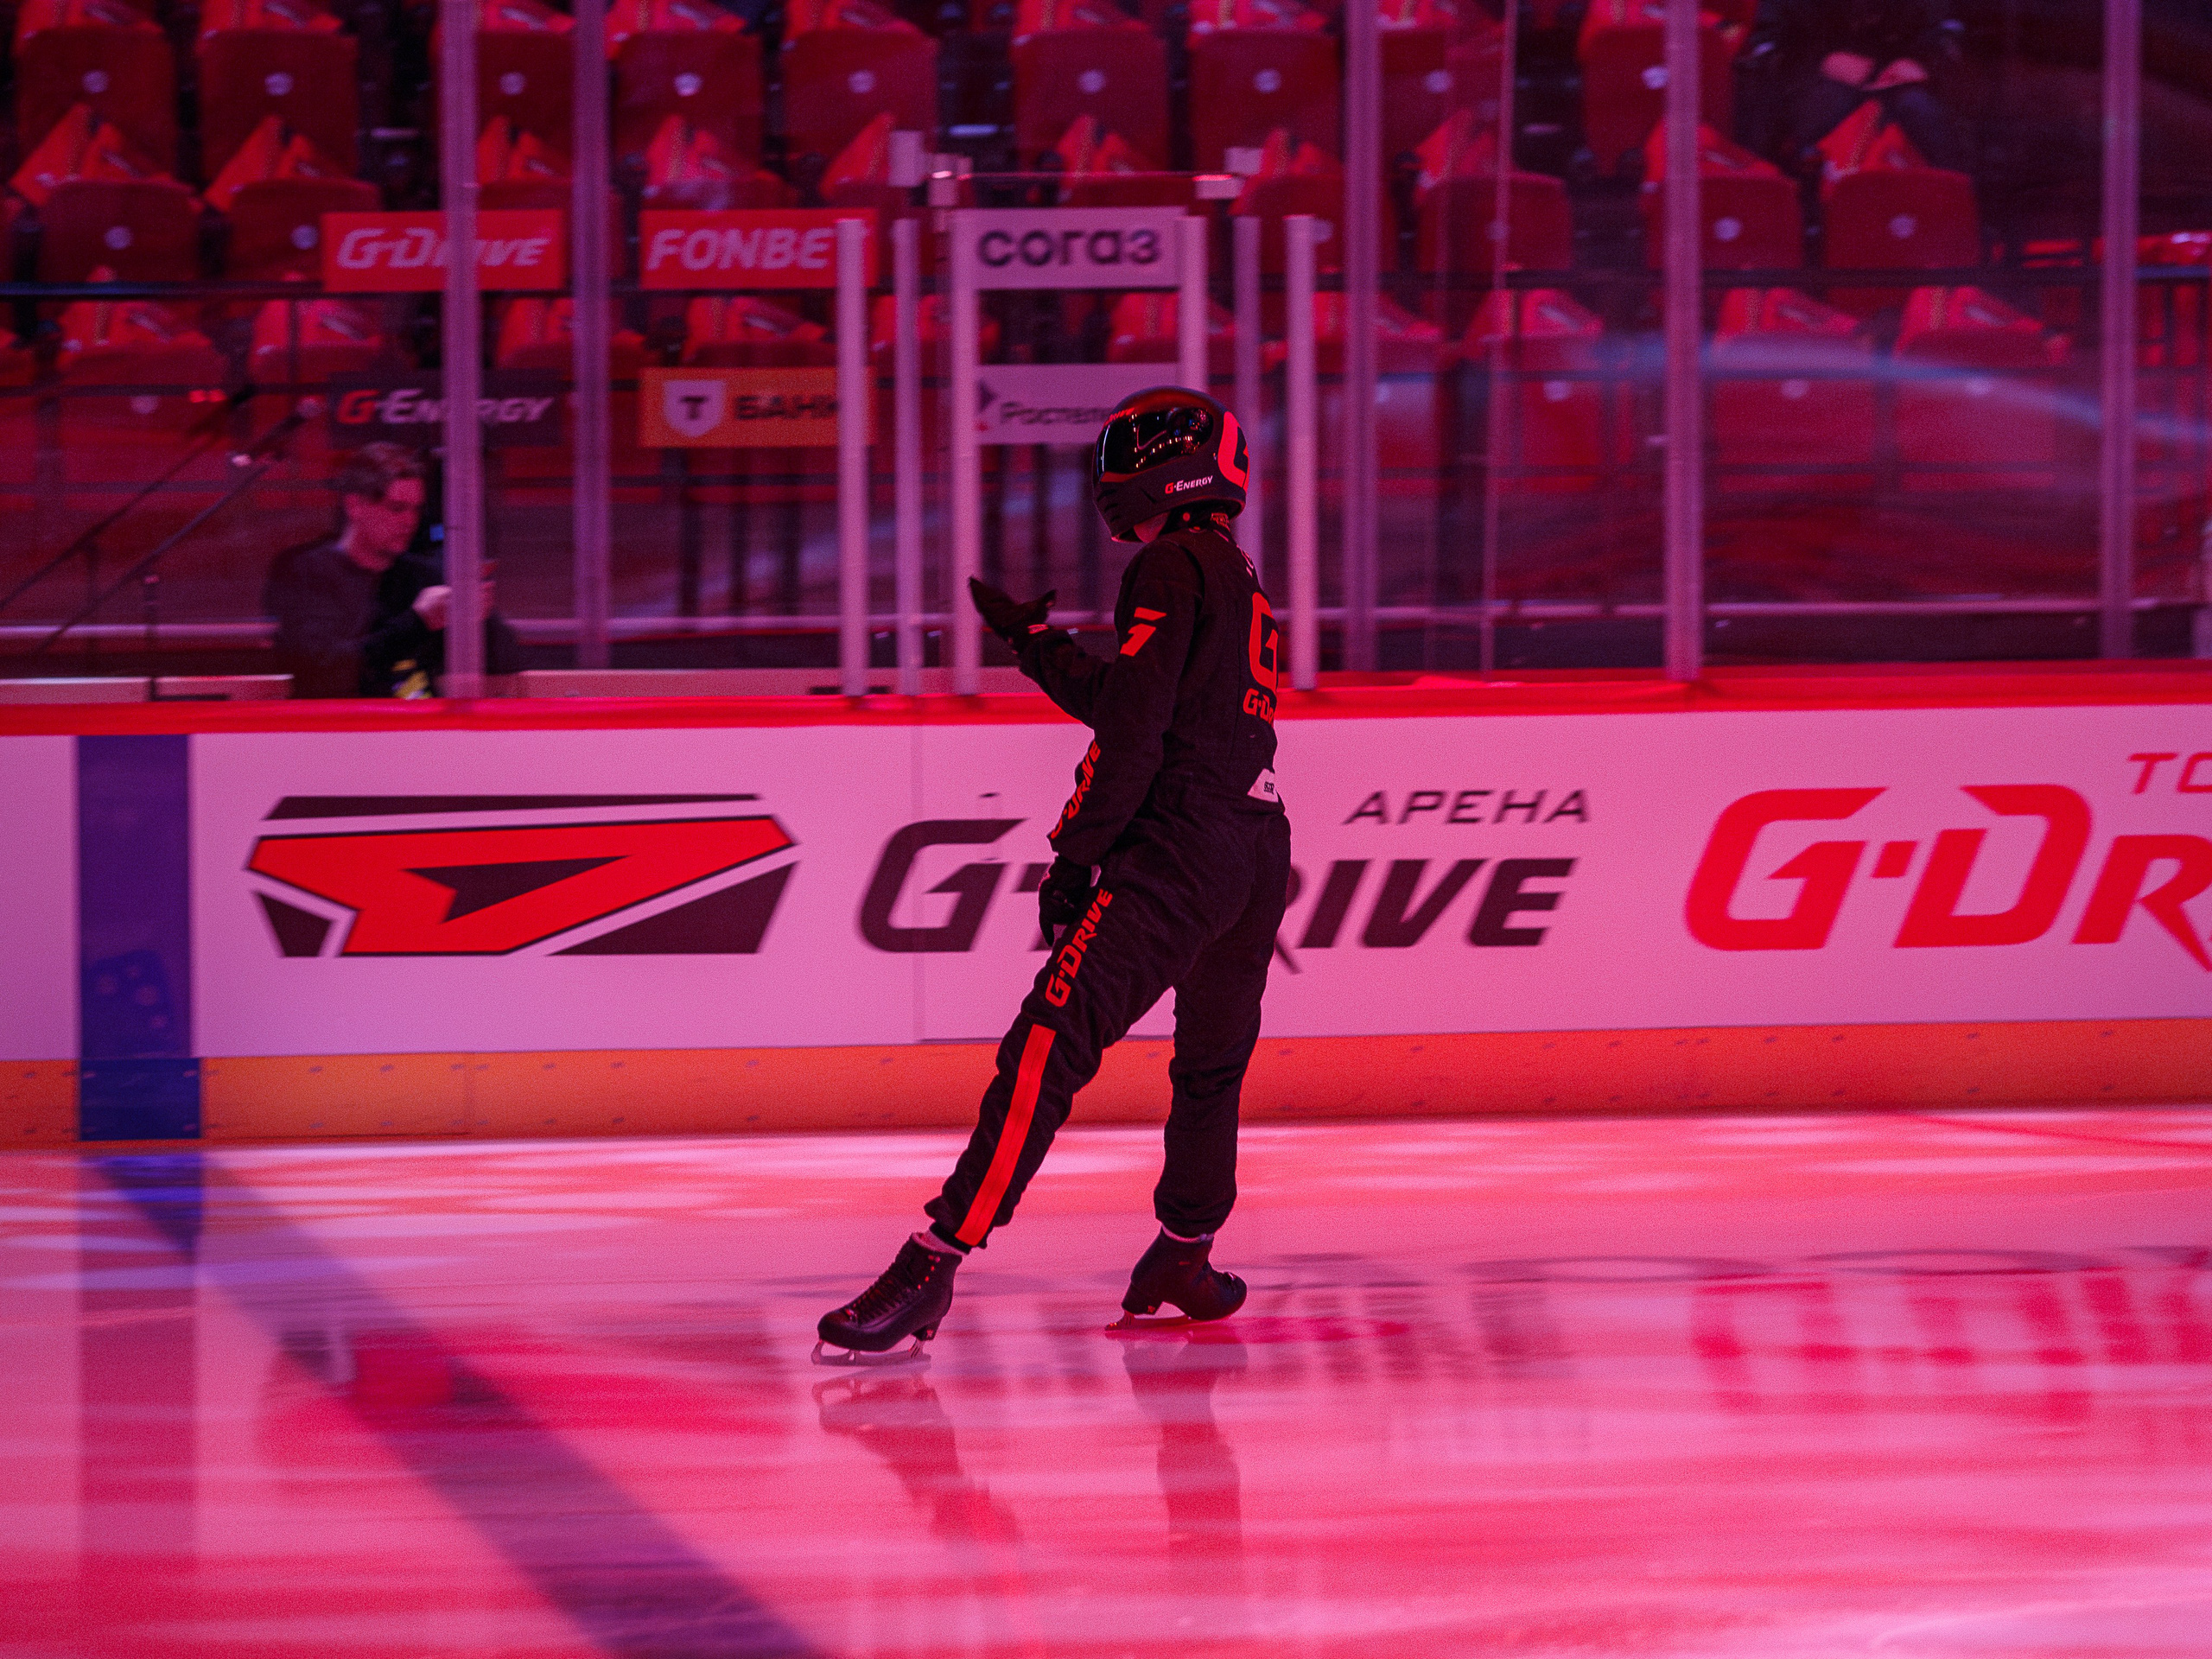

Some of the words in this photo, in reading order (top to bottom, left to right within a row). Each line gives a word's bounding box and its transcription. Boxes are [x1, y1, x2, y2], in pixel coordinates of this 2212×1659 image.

[647, 228, 838, 270] FONBE
[979, 230, 1160, 267] согаз
[1342, 790, 1588, 823] АРЕНА
